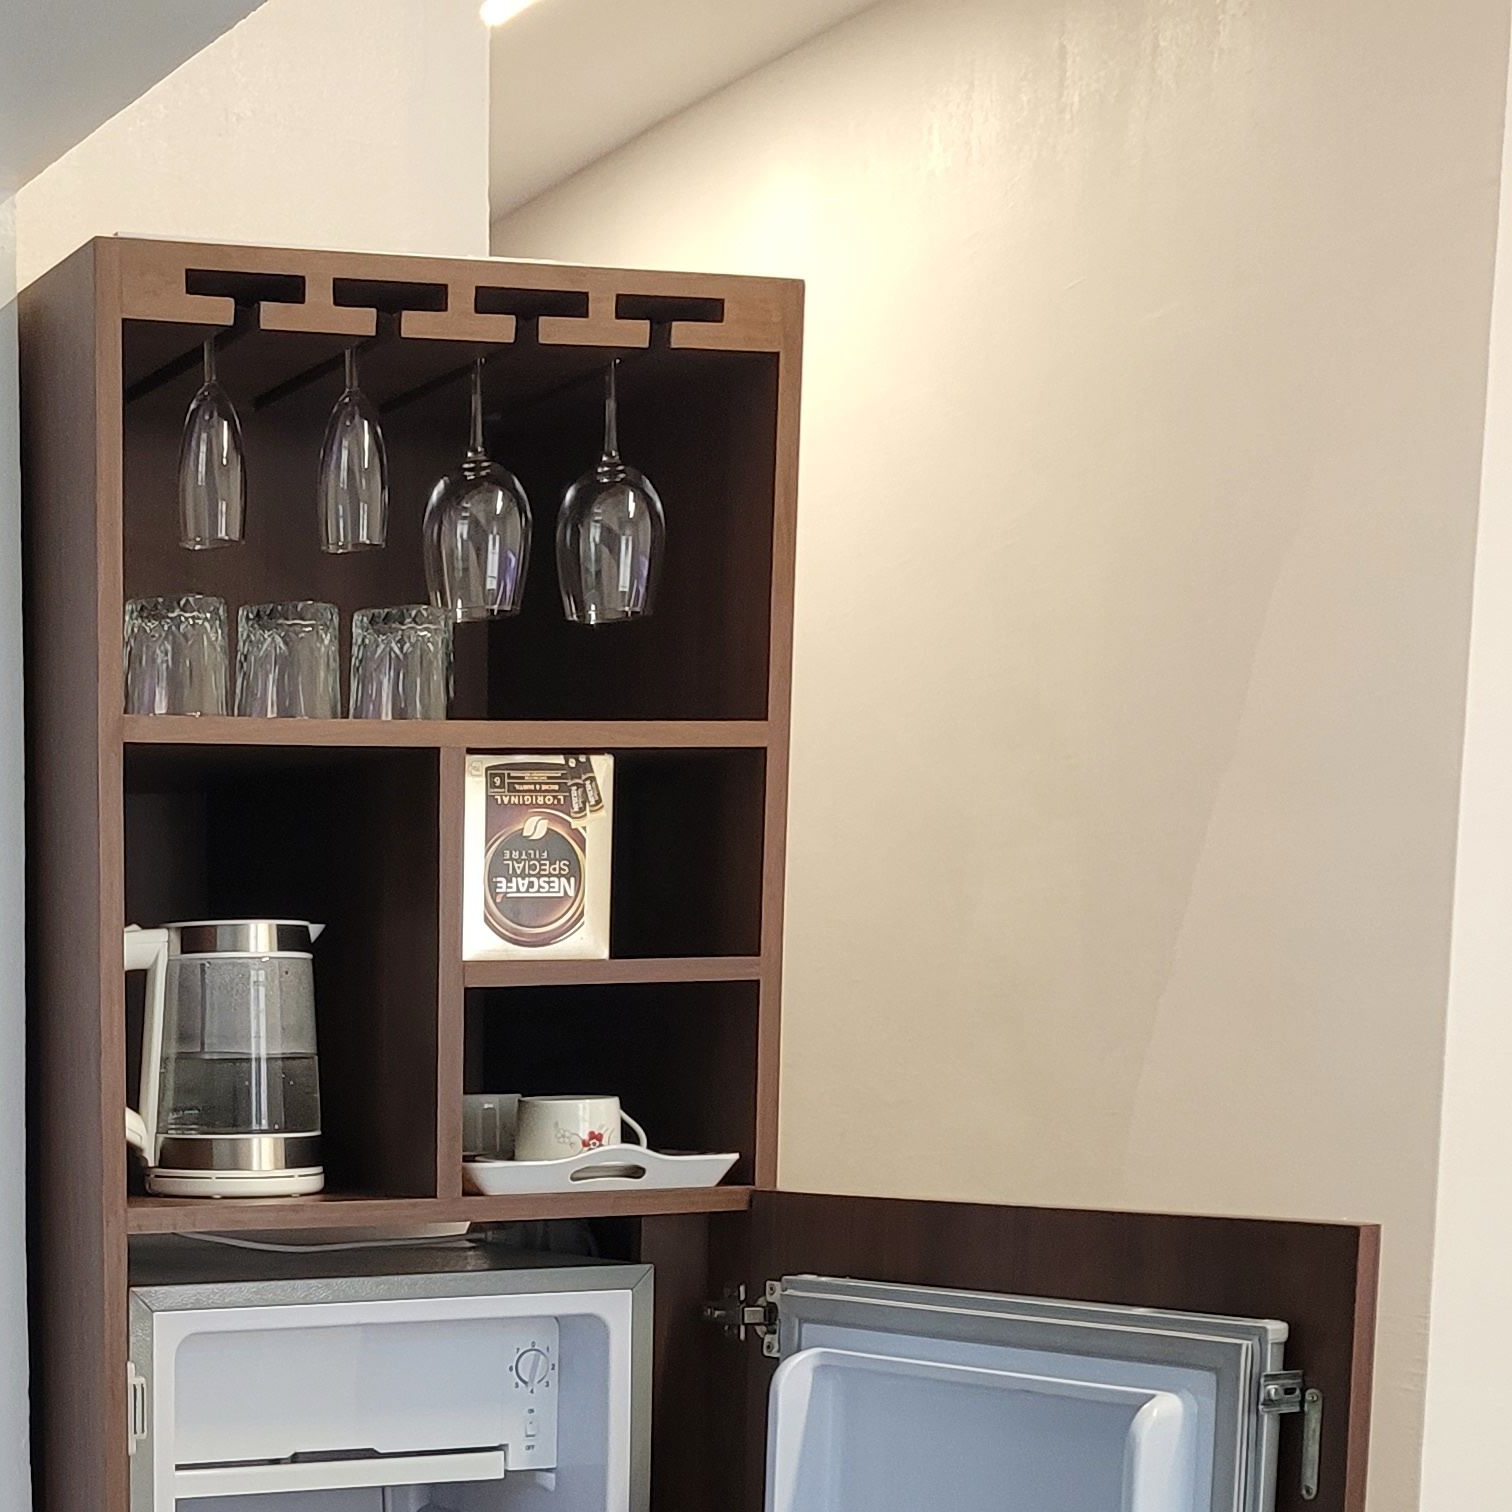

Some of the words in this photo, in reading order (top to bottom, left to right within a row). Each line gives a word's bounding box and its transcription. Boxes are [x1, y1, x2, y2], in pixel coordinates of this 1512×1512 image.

[495, 795, 564, 806] L'ORIGINAL
[503, 849, 548, 860] FILTRE
[503, 860, 570, 875] SPECIAL
